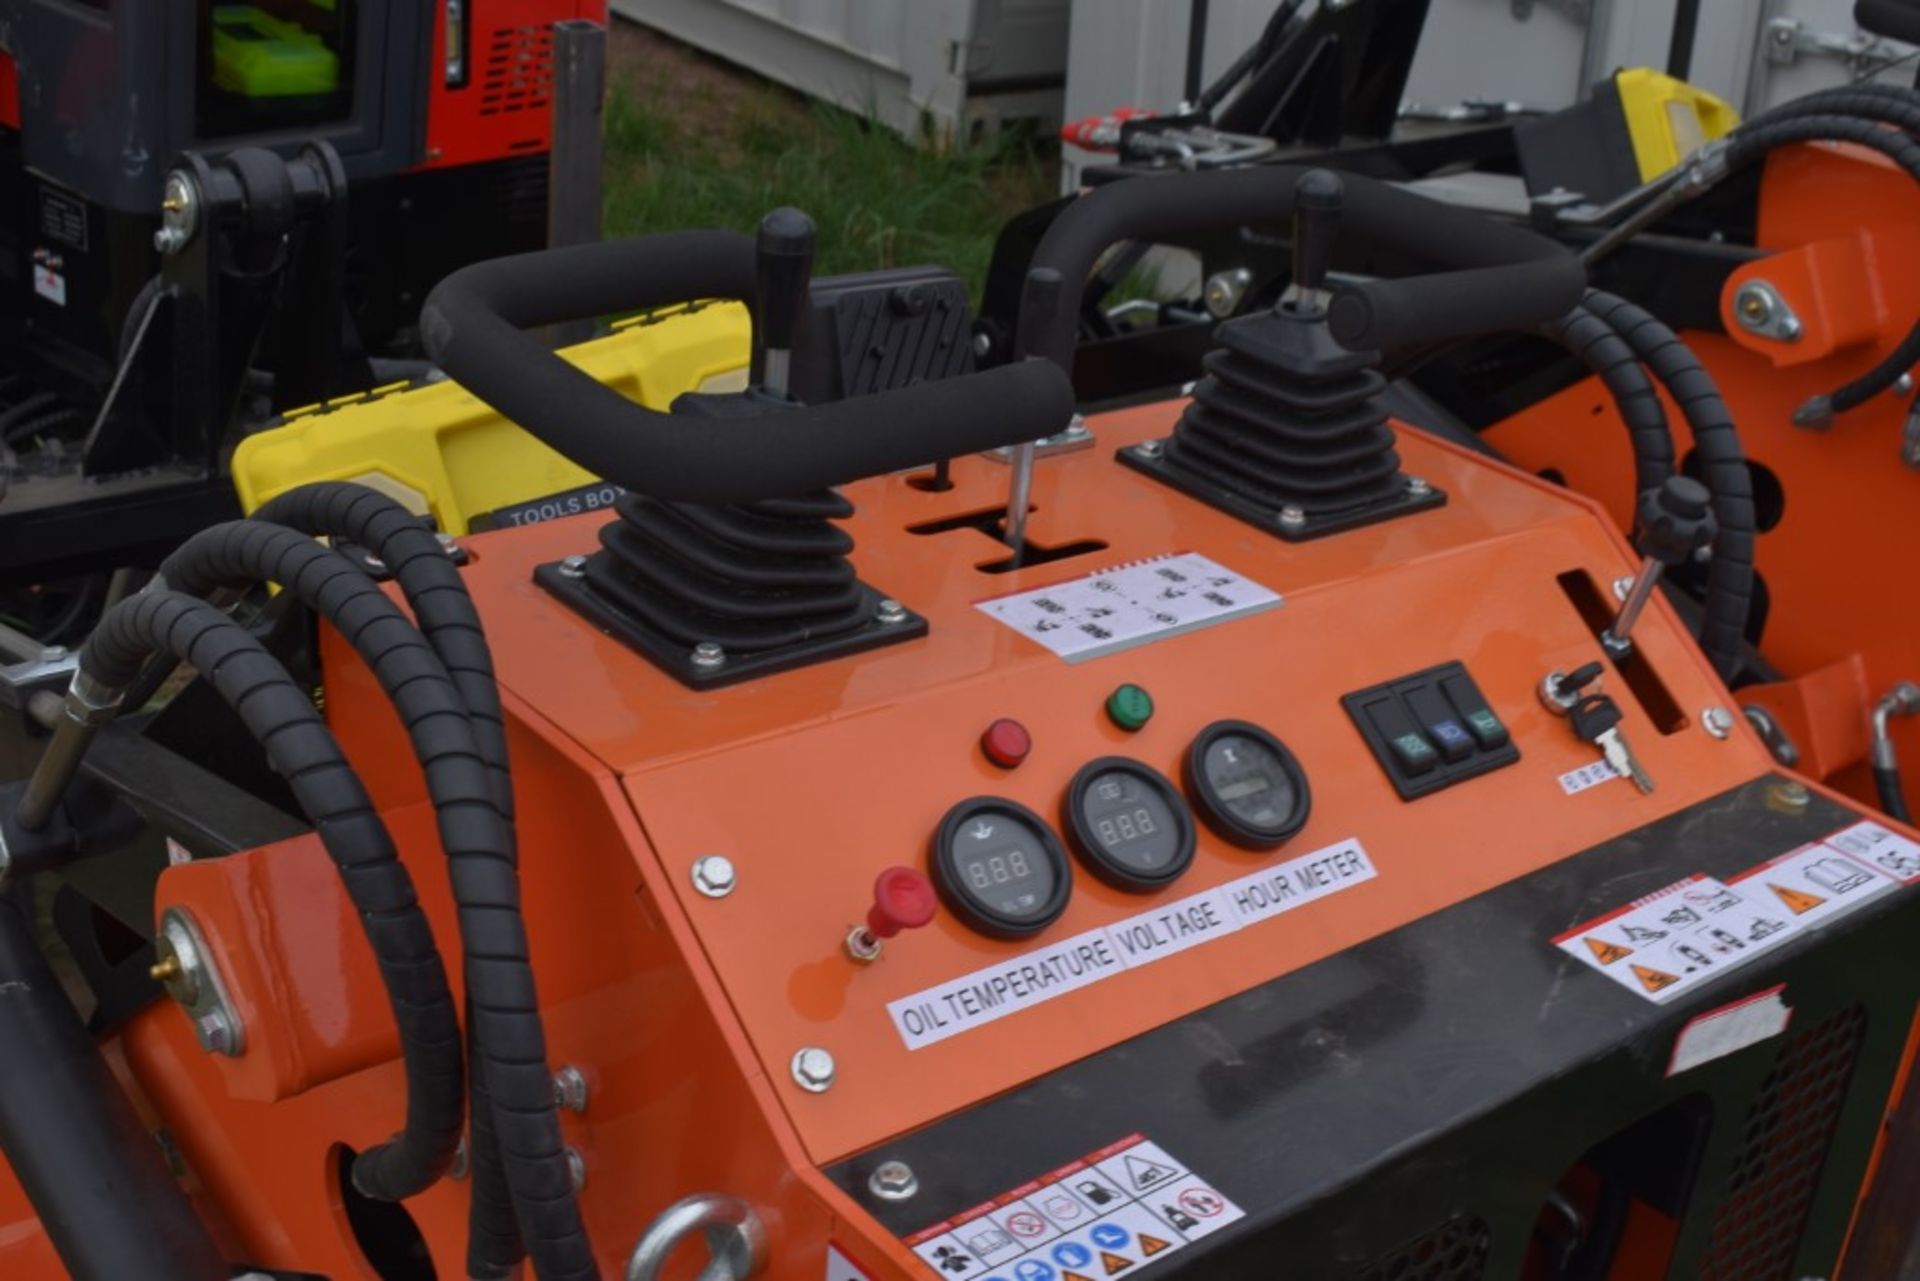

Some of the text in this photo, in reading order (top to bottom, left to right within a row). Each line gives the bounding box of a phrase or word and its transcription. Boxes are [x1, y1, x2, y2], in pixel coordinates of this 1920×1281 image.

[510, 497, 581, 527] TOOLS
[1233, 851, 1367, 915] HOUR METER
[1117, 901, 1221, 956] VOLTAGE
[901, 939, 1114, 1037] OIL TEMPERATURE
